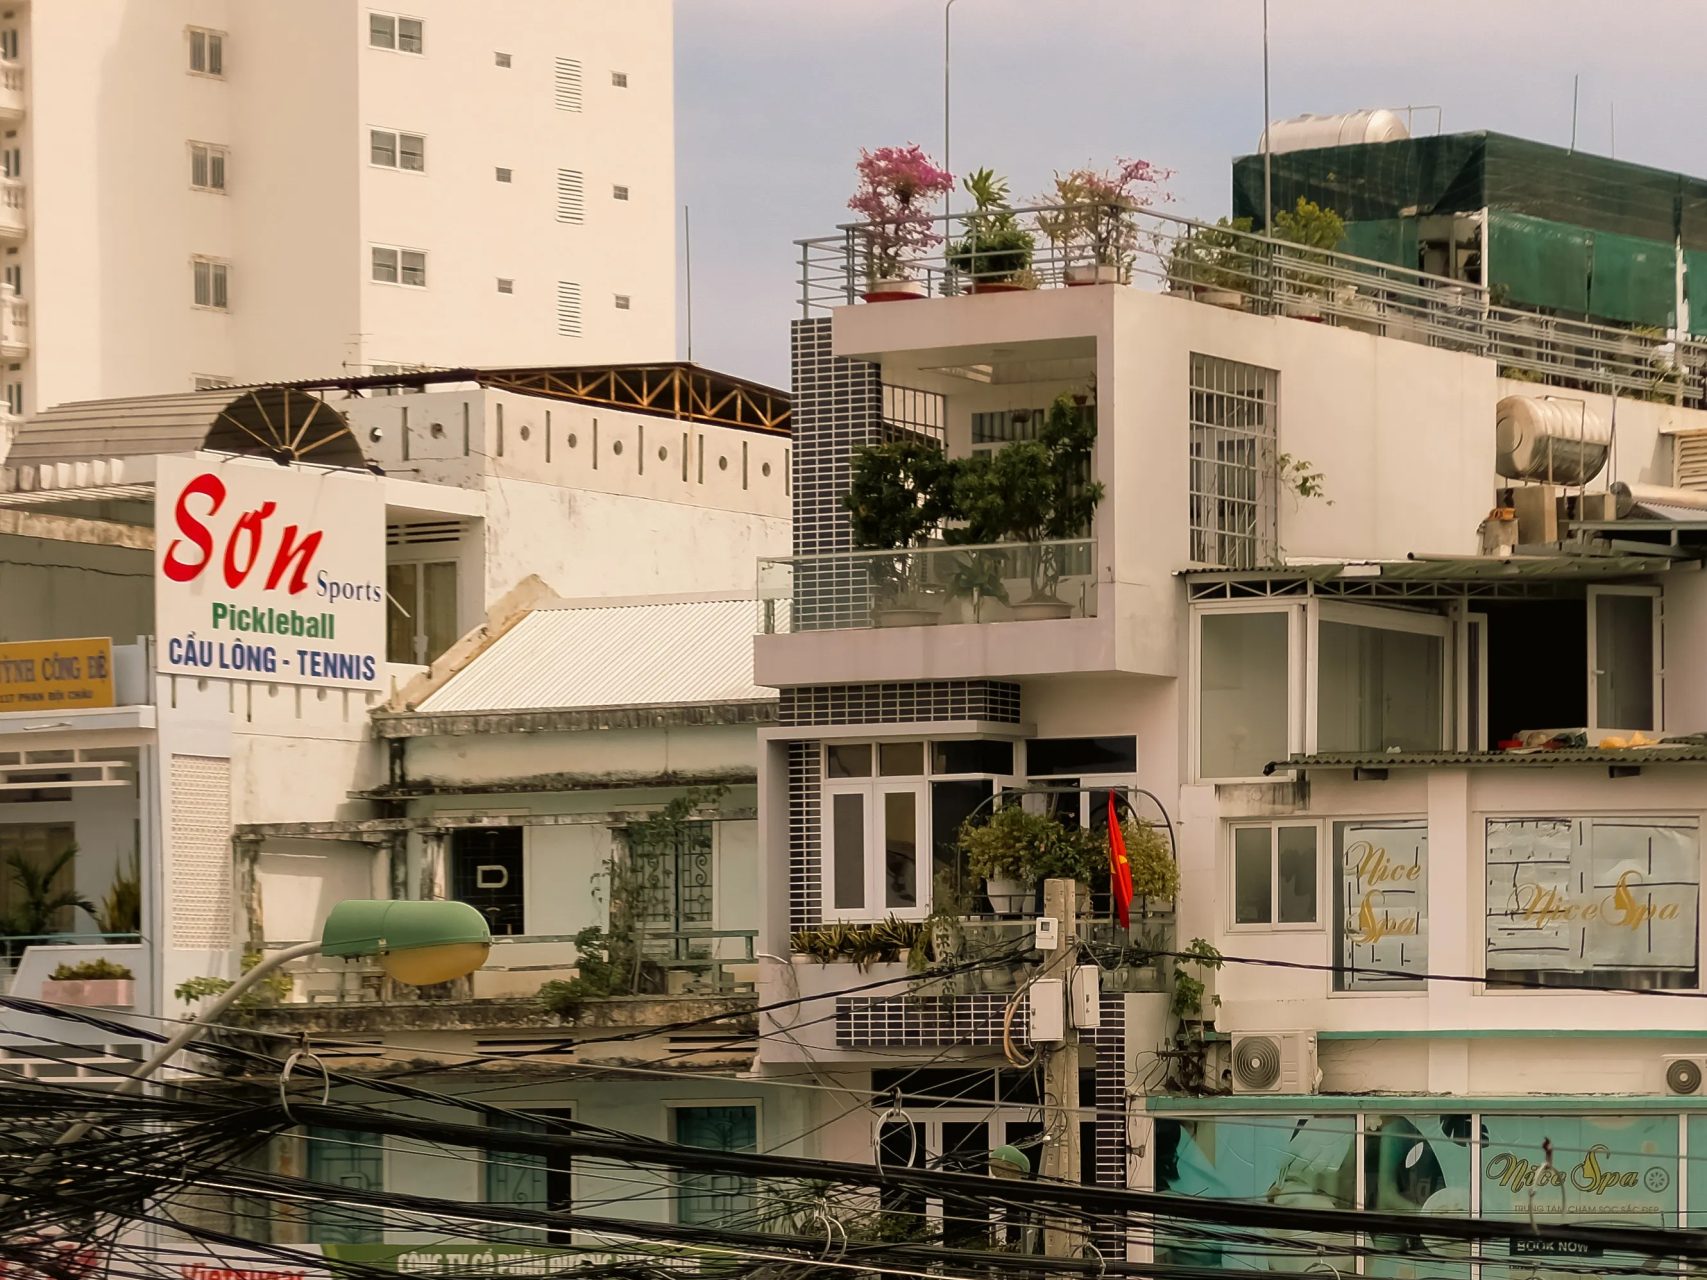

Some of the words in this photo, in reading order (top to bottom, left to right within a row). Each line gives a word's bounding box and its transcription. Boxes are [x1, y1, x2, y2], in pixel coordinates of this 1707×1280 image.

[163, 473, 323, 595] Sơn
[316, 569, 382, 603] Sports
[211, 602, 335, 639] Pickleball
[219, 638, 276, 673] LÔNG
[297, 649, 376, 681] TENNIS
[1343, 840, 1421, 886] Nice
[1346, 889, 1416, 944] Spa
[1506, 882, 1598, 929] Nice
[1600, 870, 1680, 931] Spa
[1486, 1152, 1567, 1193] Nice
[1570, 1144, 1639, 1195] Spa
[1558, 1241, 1589, 1253] NOW
